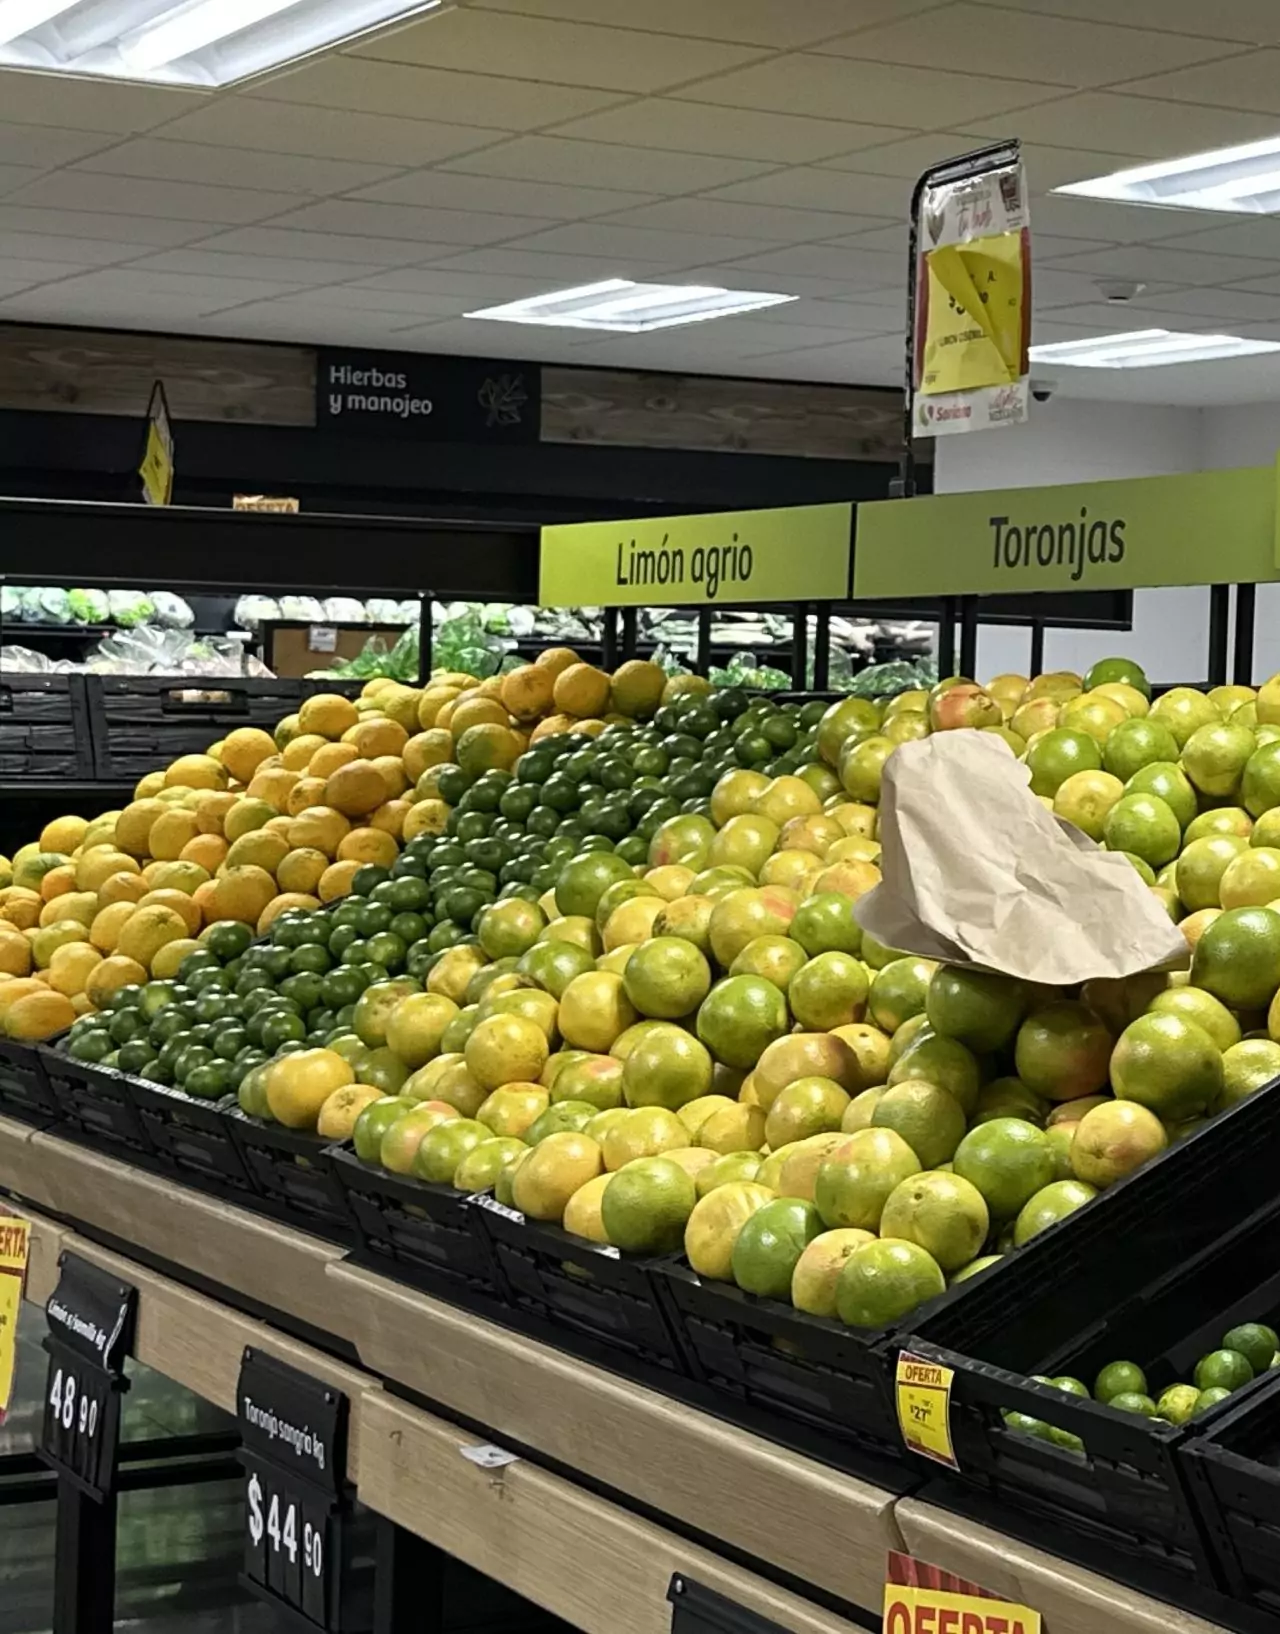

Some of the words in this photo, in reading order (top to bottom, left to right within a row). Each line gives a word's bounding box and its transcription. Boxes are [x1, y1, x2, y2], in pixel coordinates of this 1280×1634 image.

[329, 365, 407, 389] Hierbas
[329, 394, 342, 415] y
[347, 394, 433, 418] manojeo
[989, 506, 1126, 581] Toronjas
[616, 532, 684, 585] Limón
[690, 532, 753, 598] agrio
[0, 1225, 26, 1259] ERTA
[905, 1364, 942, 1384] OFERTA
[50, 1369, 76, 1429] 48
[244, 1396, 279, 1439] Toronja
[248, 1473, 298, 1564] $44
[305, 1522, 323, 1577] 90
[886, 1601, 1026, 1634] OFE
